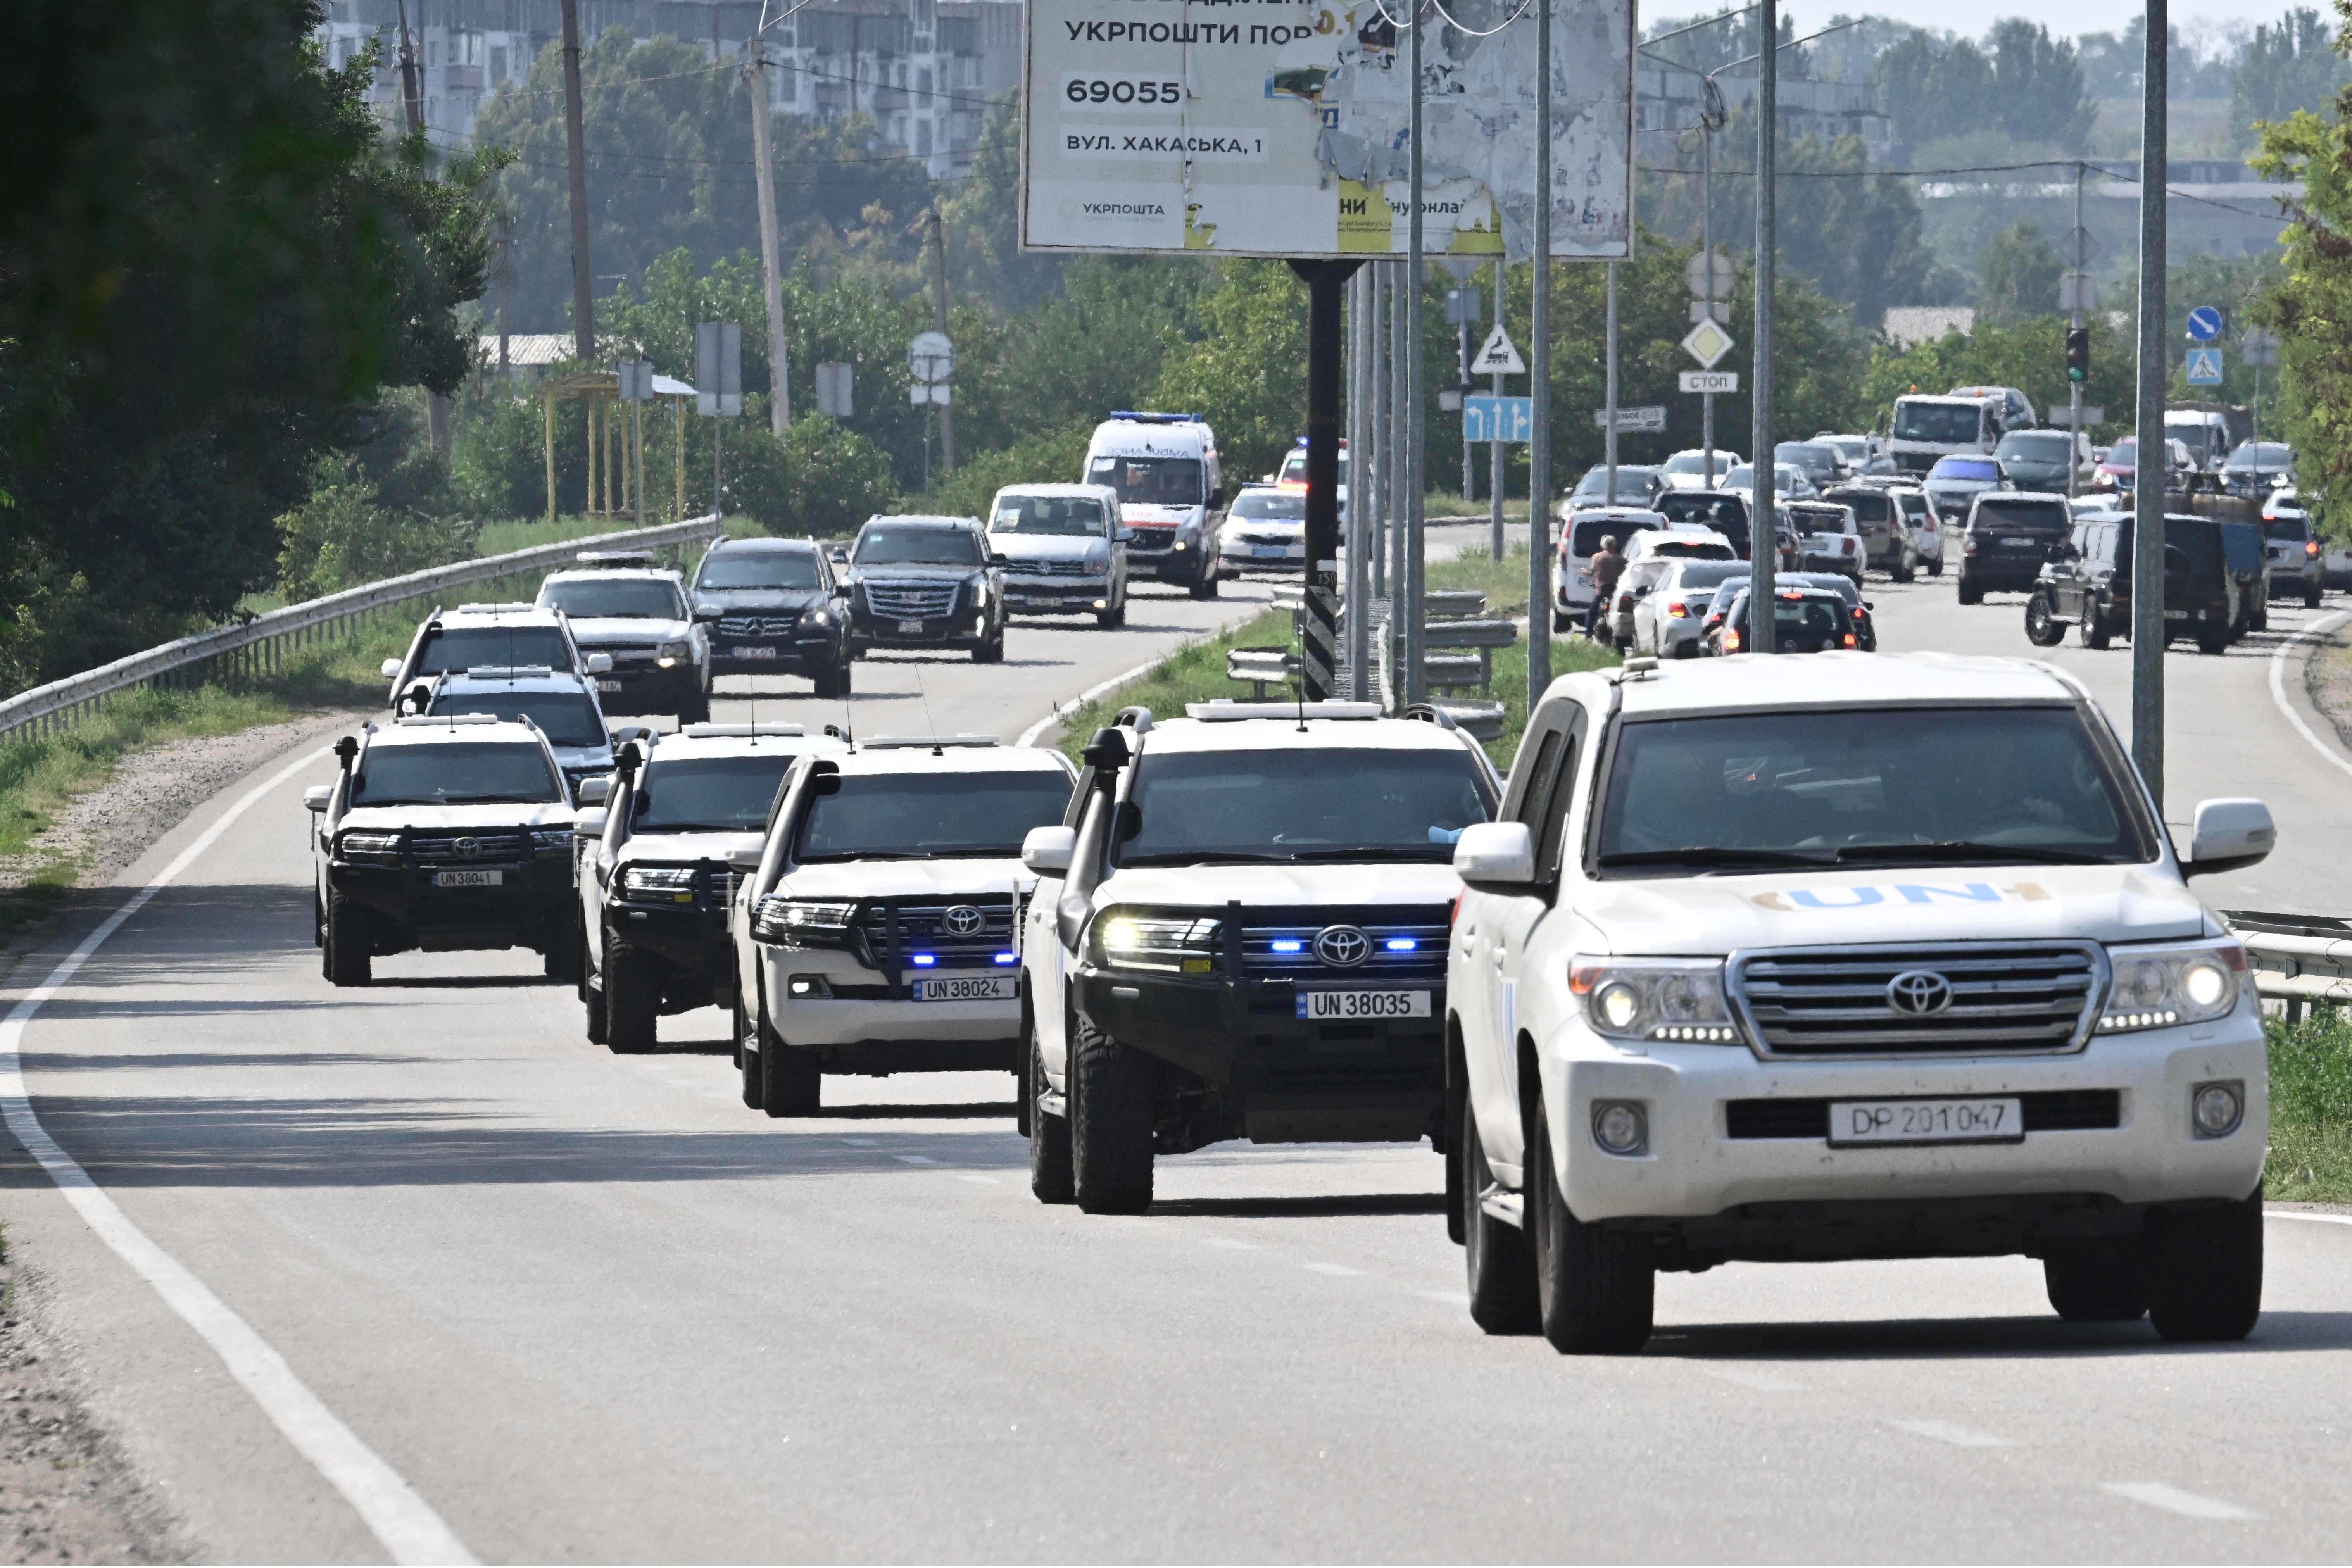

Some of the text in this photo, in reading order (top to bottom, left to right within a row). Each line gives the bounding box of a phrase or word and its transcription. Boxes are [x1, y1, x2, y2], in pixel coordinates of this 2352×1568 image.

[1065, 21, 1318, 45] УКРПОШТИ ПОР
[1066, 79, 1180, 104] 69055
[1067, 136, 1261, 155] ВУЛ. ХАКАСЬКА, 1
[1083, 204, 1165, 215] УКРПОШТА
[1690, 376, 1727, 388] СТОП
[441, 872, 490, 885] UN 38041
[1786, 883, 2003, 907] UN
[927, 982, 947, 998] UN
[951, 980, 1000, 997] 38024
[1315, 994, 1341, 1016] UN
[1345, 994, 1411, 1016] 38035
[1852, 1107, 1893, 1135] DP
